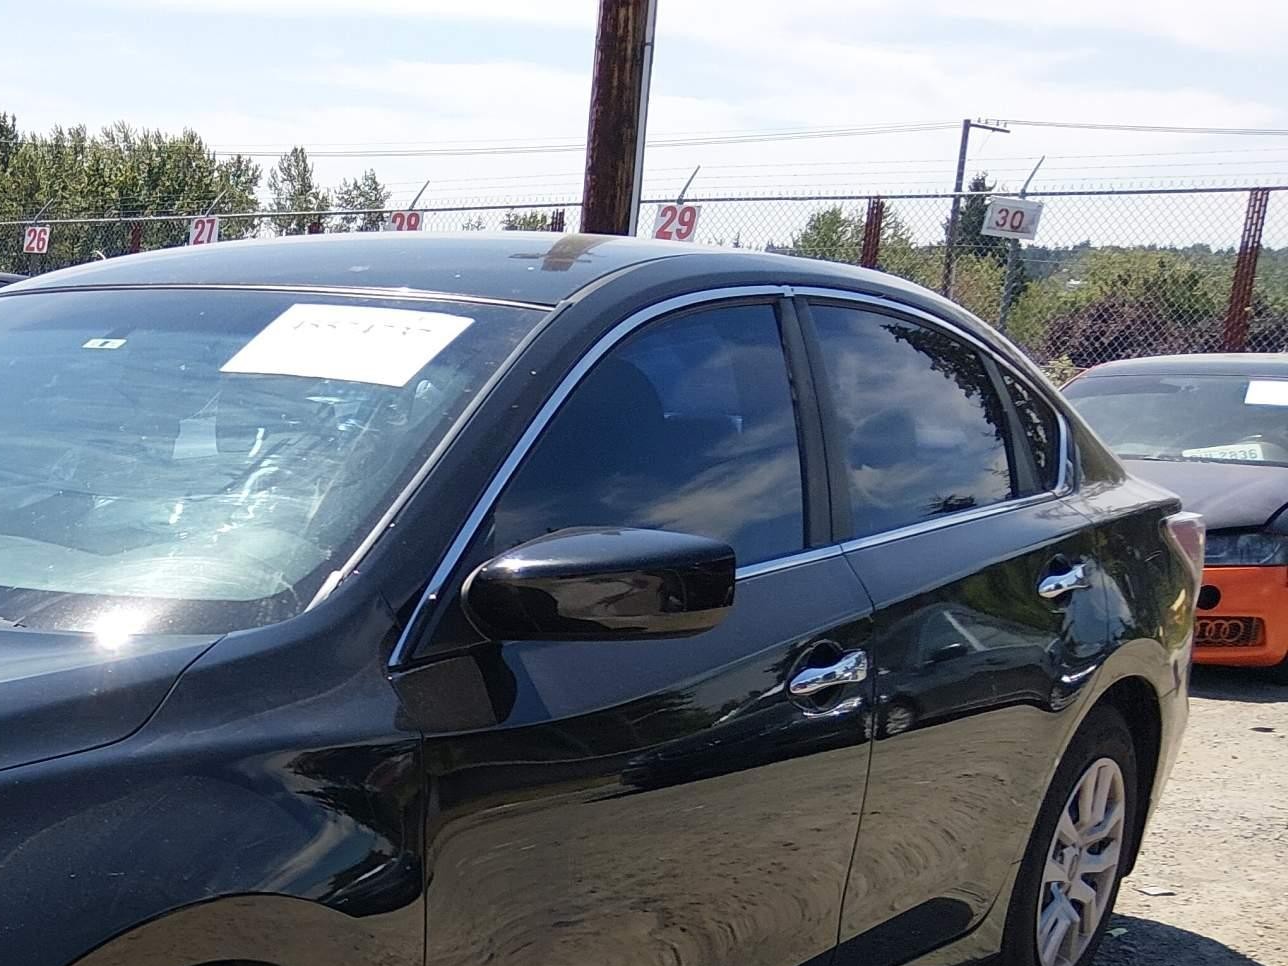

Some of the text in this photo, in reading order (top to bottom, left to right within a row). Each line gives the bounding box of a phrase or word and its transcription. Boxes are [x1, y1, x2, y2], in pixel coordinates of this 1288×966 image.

[655, 205, 697, 240] 29
[994, 207, 1025, 230] 30
[25, 228, 47, 252] 26
[193, 219, 216, 245] 27
